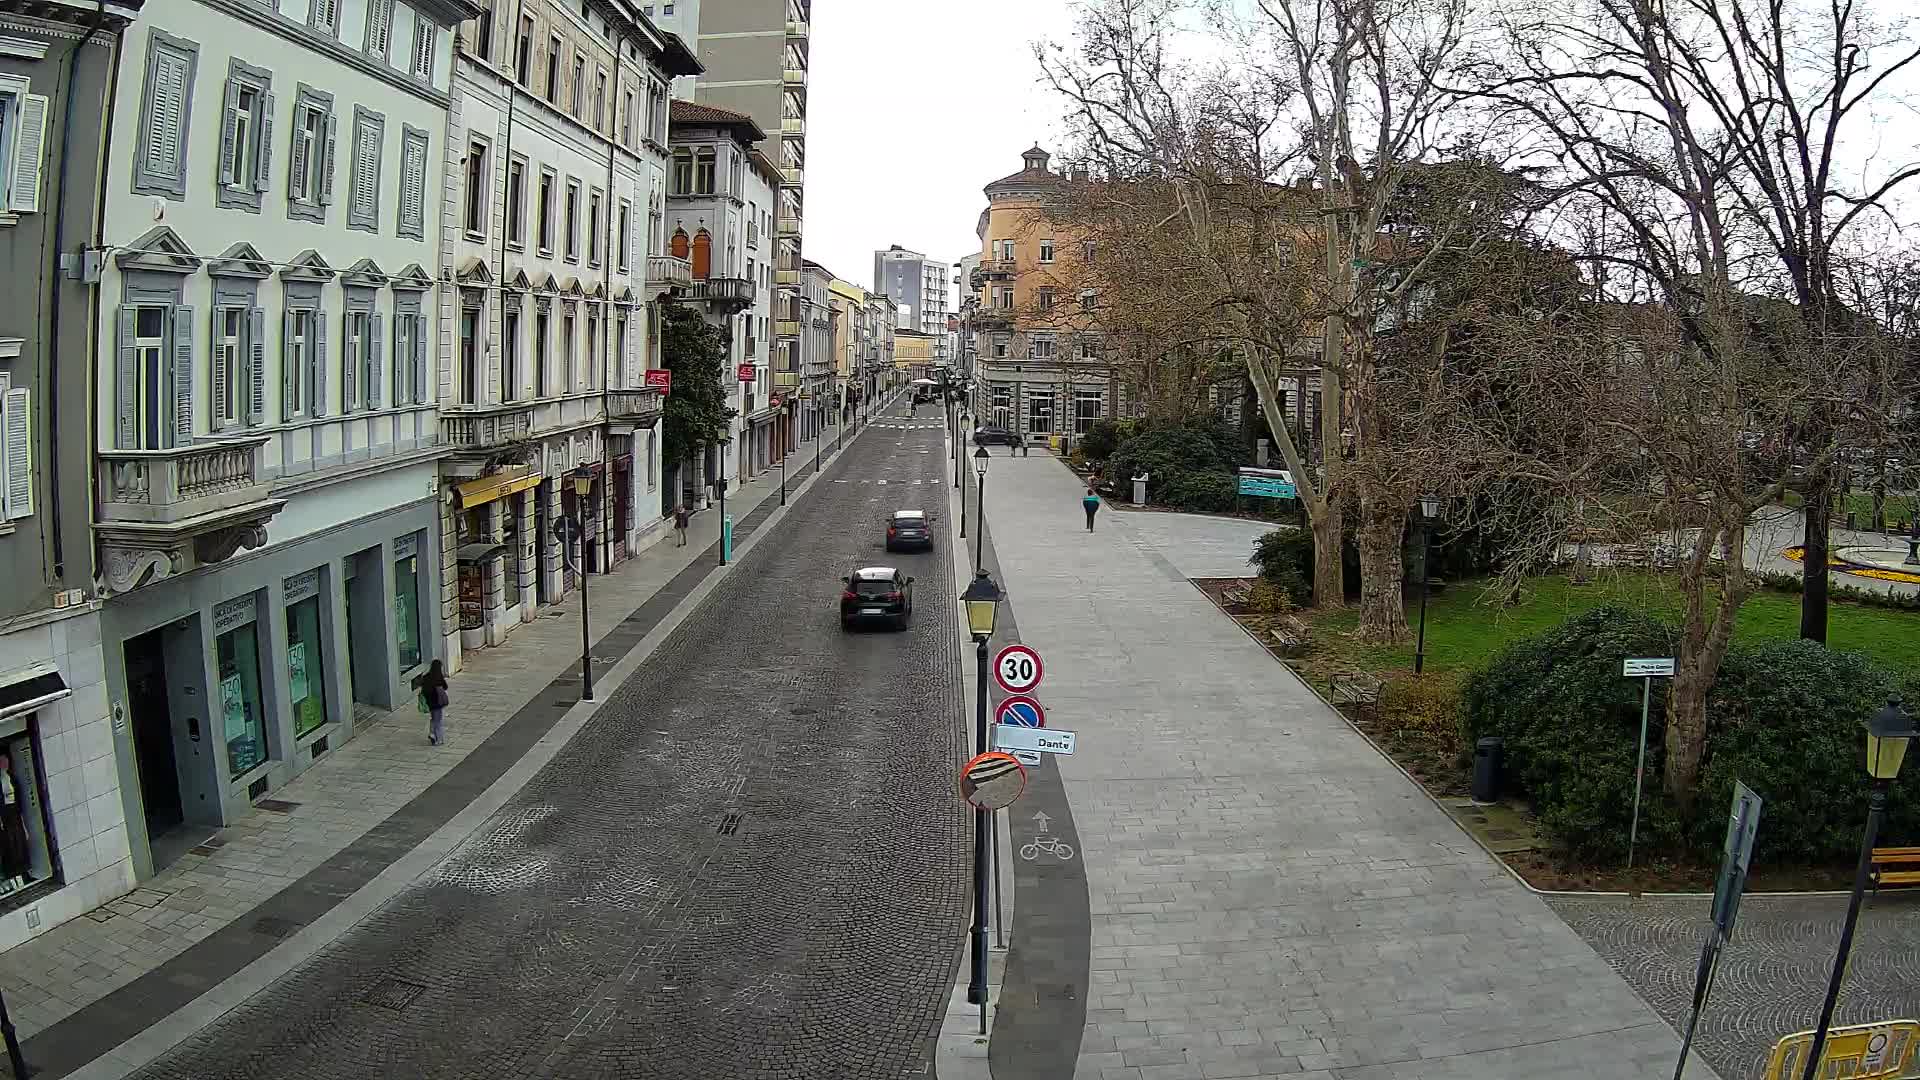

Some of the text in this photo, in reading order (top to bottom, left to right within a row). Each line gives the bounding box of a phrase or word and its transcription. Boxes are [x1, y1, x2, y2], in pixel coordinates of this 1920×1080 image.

[233, 597, 253, 611] CREDITO
[1005, 658, 1033, 681] 30
[1038, 738, 1069, 750] Dante
